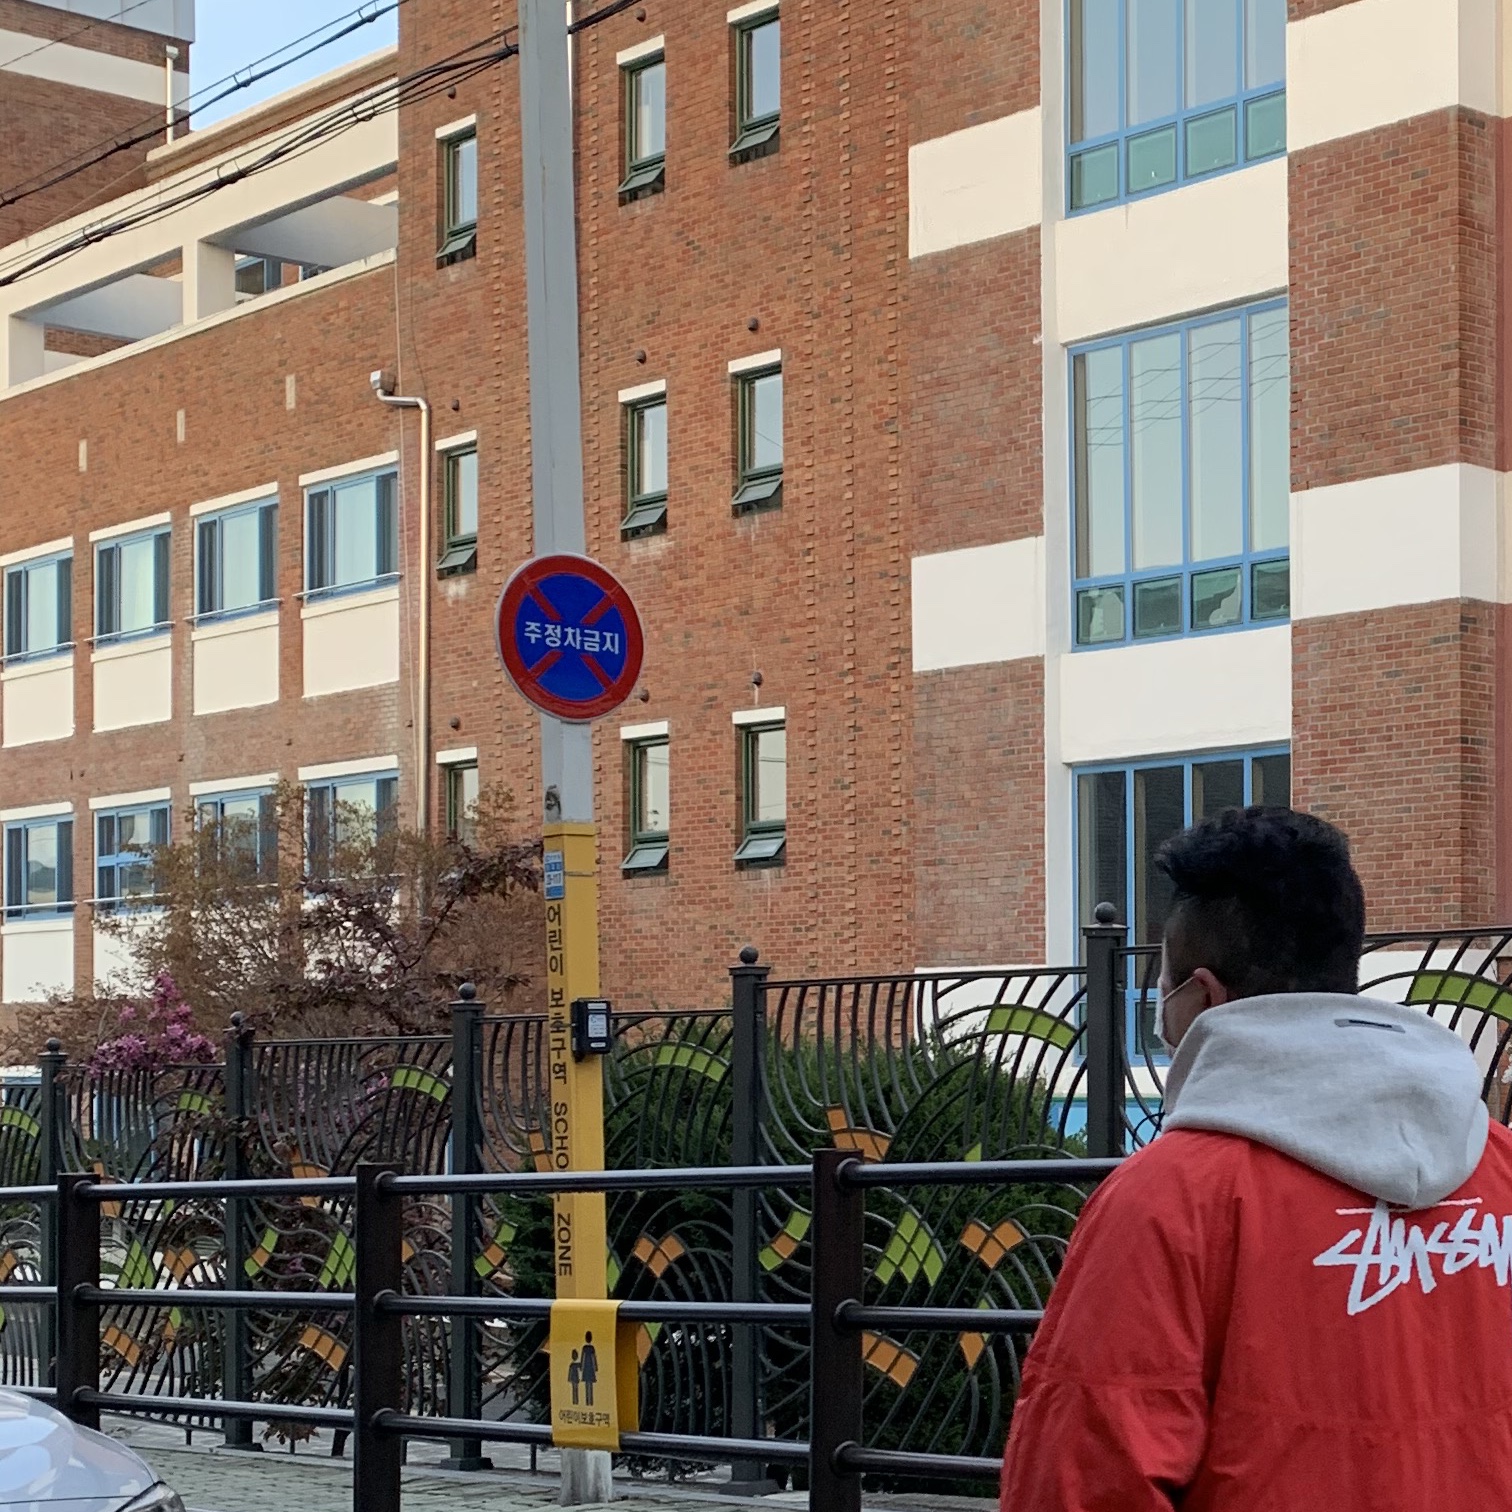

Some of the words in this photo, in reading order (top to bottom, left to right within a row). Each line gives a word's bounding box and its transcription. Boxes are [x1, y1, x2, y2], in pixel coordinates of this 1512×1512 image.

[524, 621, 620, 655] 주정차금지
[547, 903, 564, 976] 어린이
[554, 1102, 570, 1203] SCHO
[557, 1213, 572, 1277] ZONE
[559, 1409, 611, 1428] 어린이보호구역
